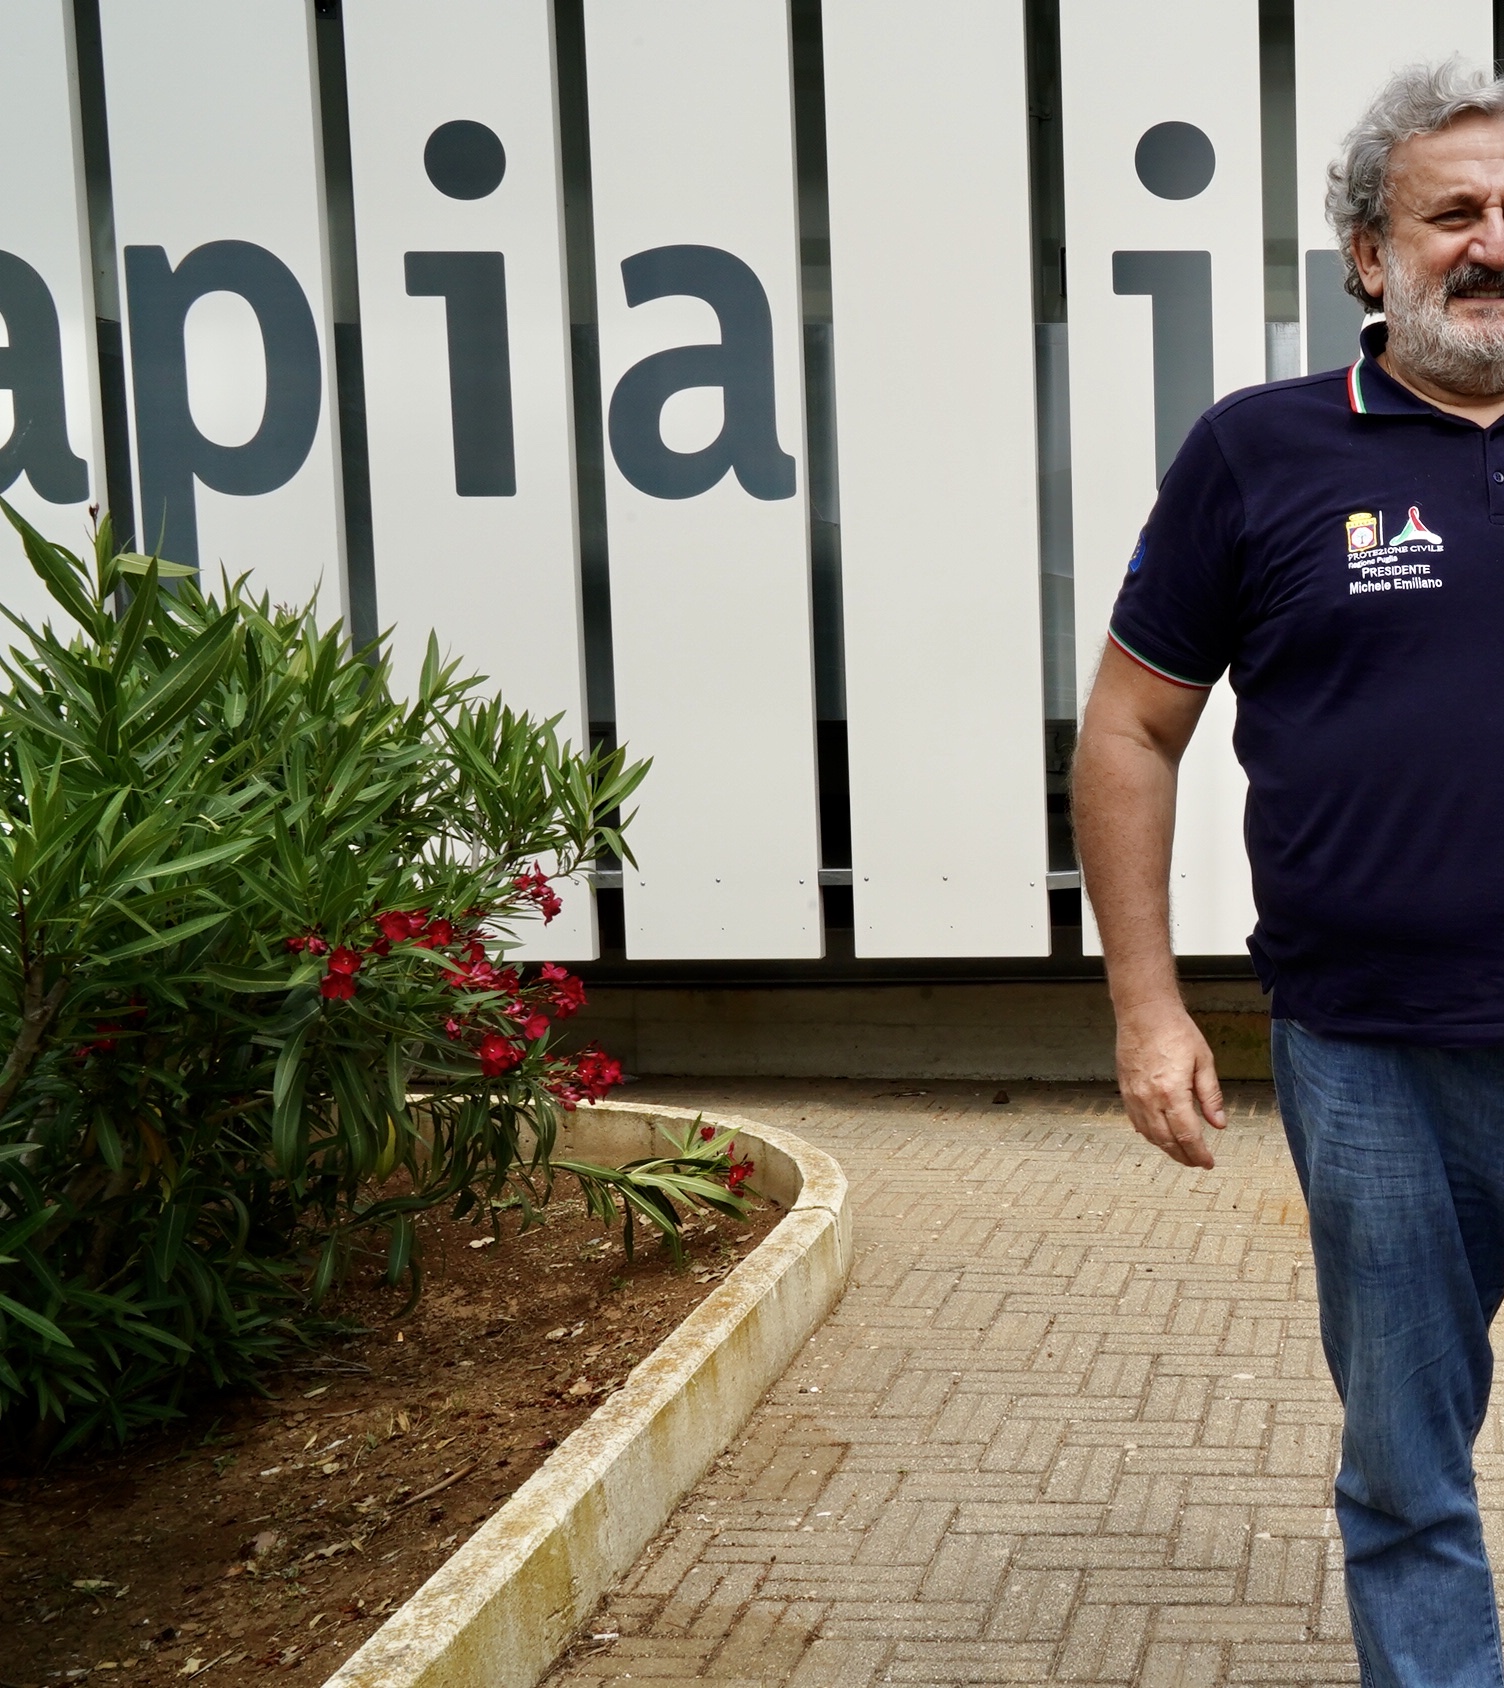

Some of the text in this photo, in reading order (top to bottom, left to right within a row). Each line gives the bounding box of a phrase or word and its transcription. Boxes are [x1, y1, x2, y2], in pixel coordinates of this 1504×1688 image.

[1347, 544, 1444, 561] PROTEZIONE CIVILE
[1377, 555, 1398, 564] Puglia
[1361, 564, 1431, 579] PRESIDENTE
[1349, 576, 1443, 595] Michele Emiliano
